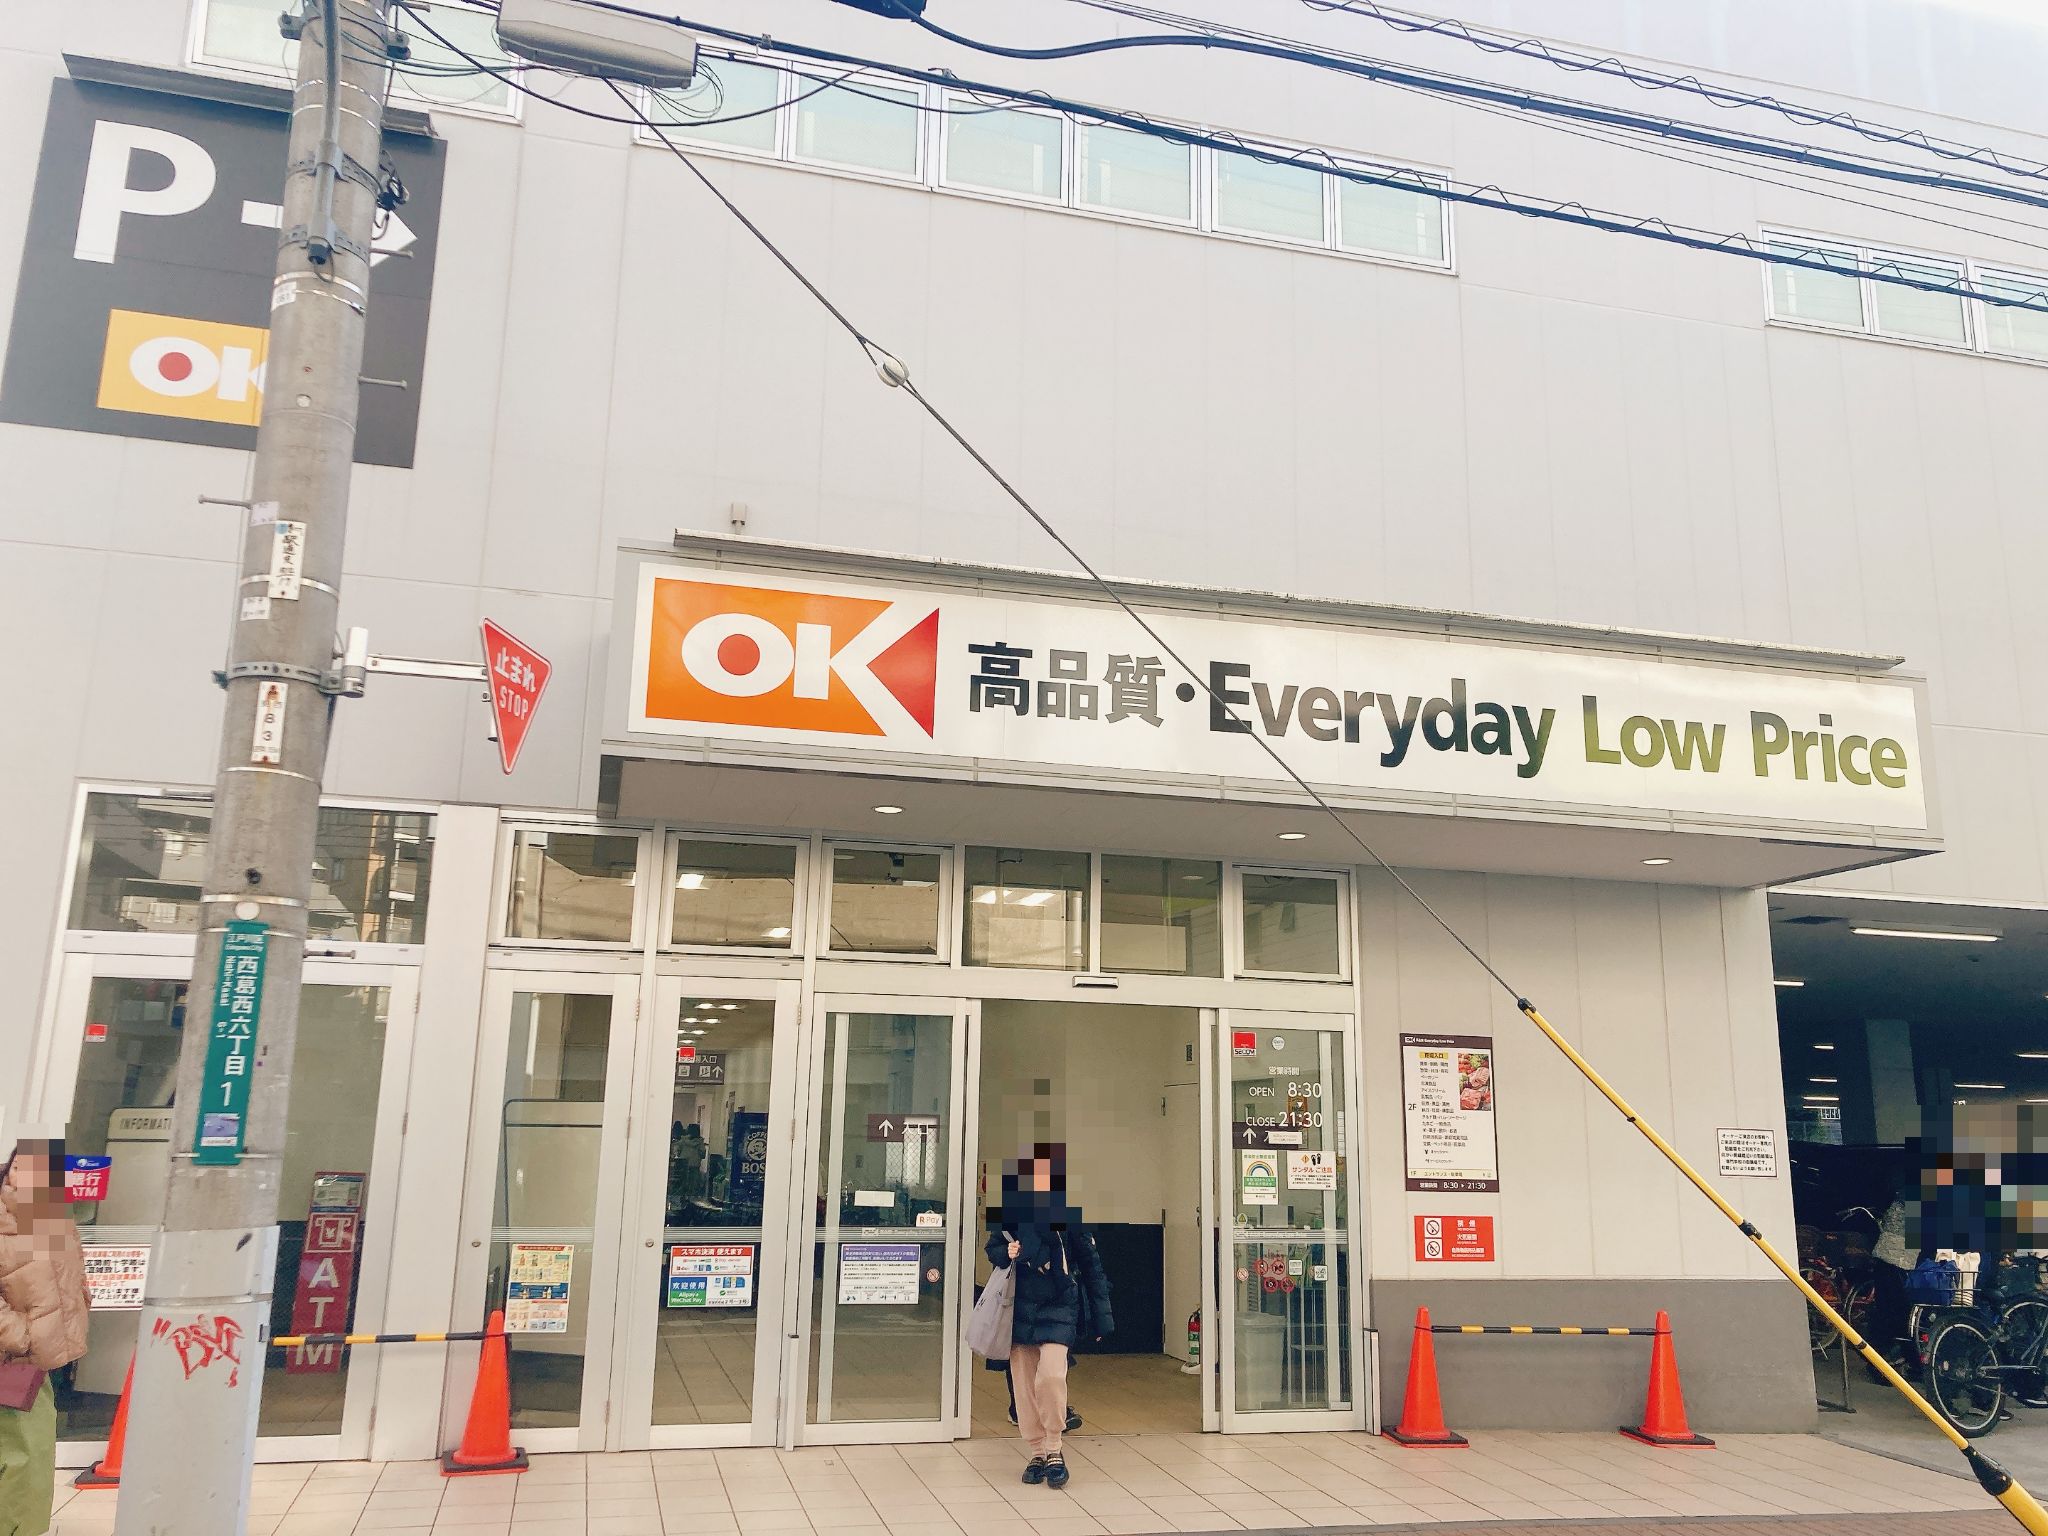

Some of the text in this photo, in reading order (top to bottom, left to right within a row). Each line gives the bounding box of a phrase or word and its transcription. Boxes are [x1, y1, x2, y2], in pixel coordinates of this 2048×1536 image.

[73, 120, 217, 264] P
[494, 646, 536, 693] 止まれ
[682, 600, 938, 738] OK
[499, 685, 529, 721] STOP
[1582, 694, 1726, 774] Low
[1749, 710, 1908, 789] Price
[220, 955, 260, 1107] 西葛西六丁目 1
[1268, 1066, 1300, 1076] 営業時間
[1248, 1082, 1322, 1098] OPEN 8:30
[1407, 1103, 1417, 1111] 2F
[1245, 1111, 1323, 1128] CLOSE 21:30
[901, 1122, 929, 1135] 入口
[1467, 1182, 1486, 1190] 21:30
[681, 1248, 744, 1256] スマホ決済 使えます
[672, 1281, 706, 1290] 欢迎使用
